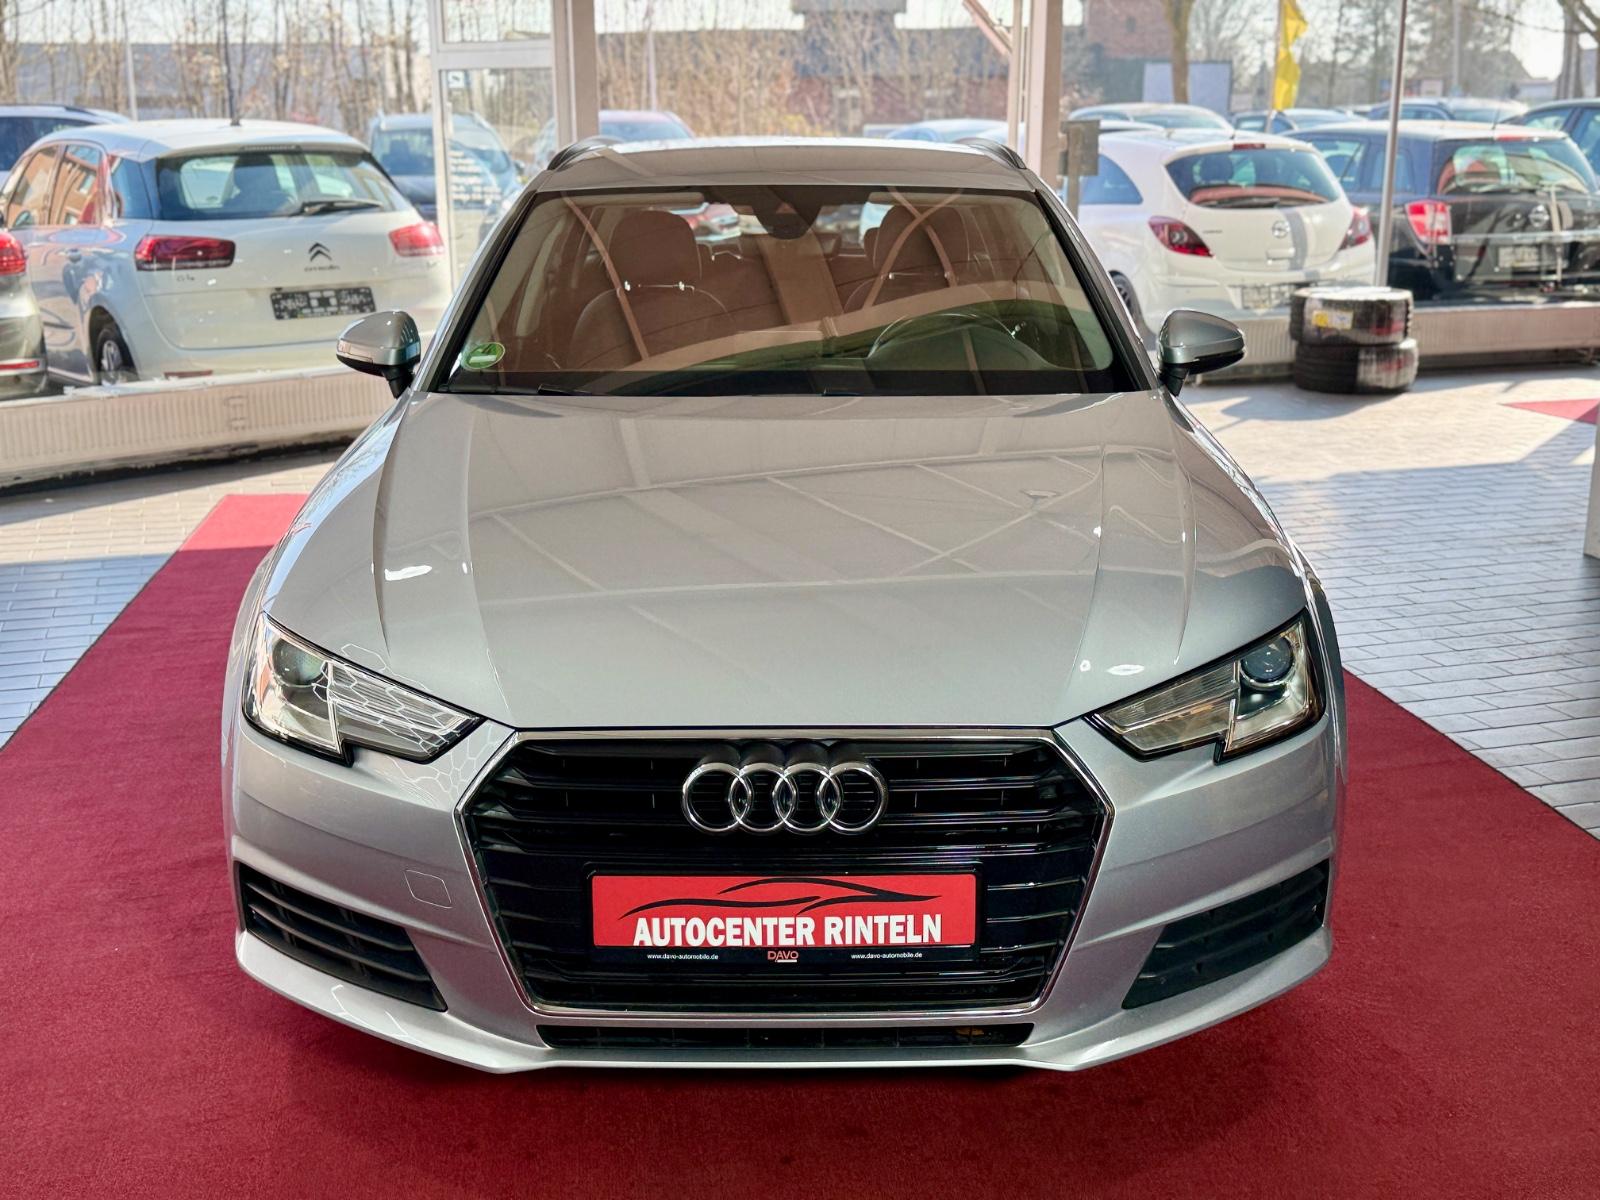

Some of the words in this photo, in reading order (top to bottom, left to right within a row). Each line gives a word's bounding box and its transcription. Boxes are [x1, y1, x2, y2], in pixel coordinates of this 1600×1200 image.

[633, 916, 815, 947] AUTOCENTER
[824, 914, 942, 945] RINTELN
[767, 951, 799, 961] DAVO
